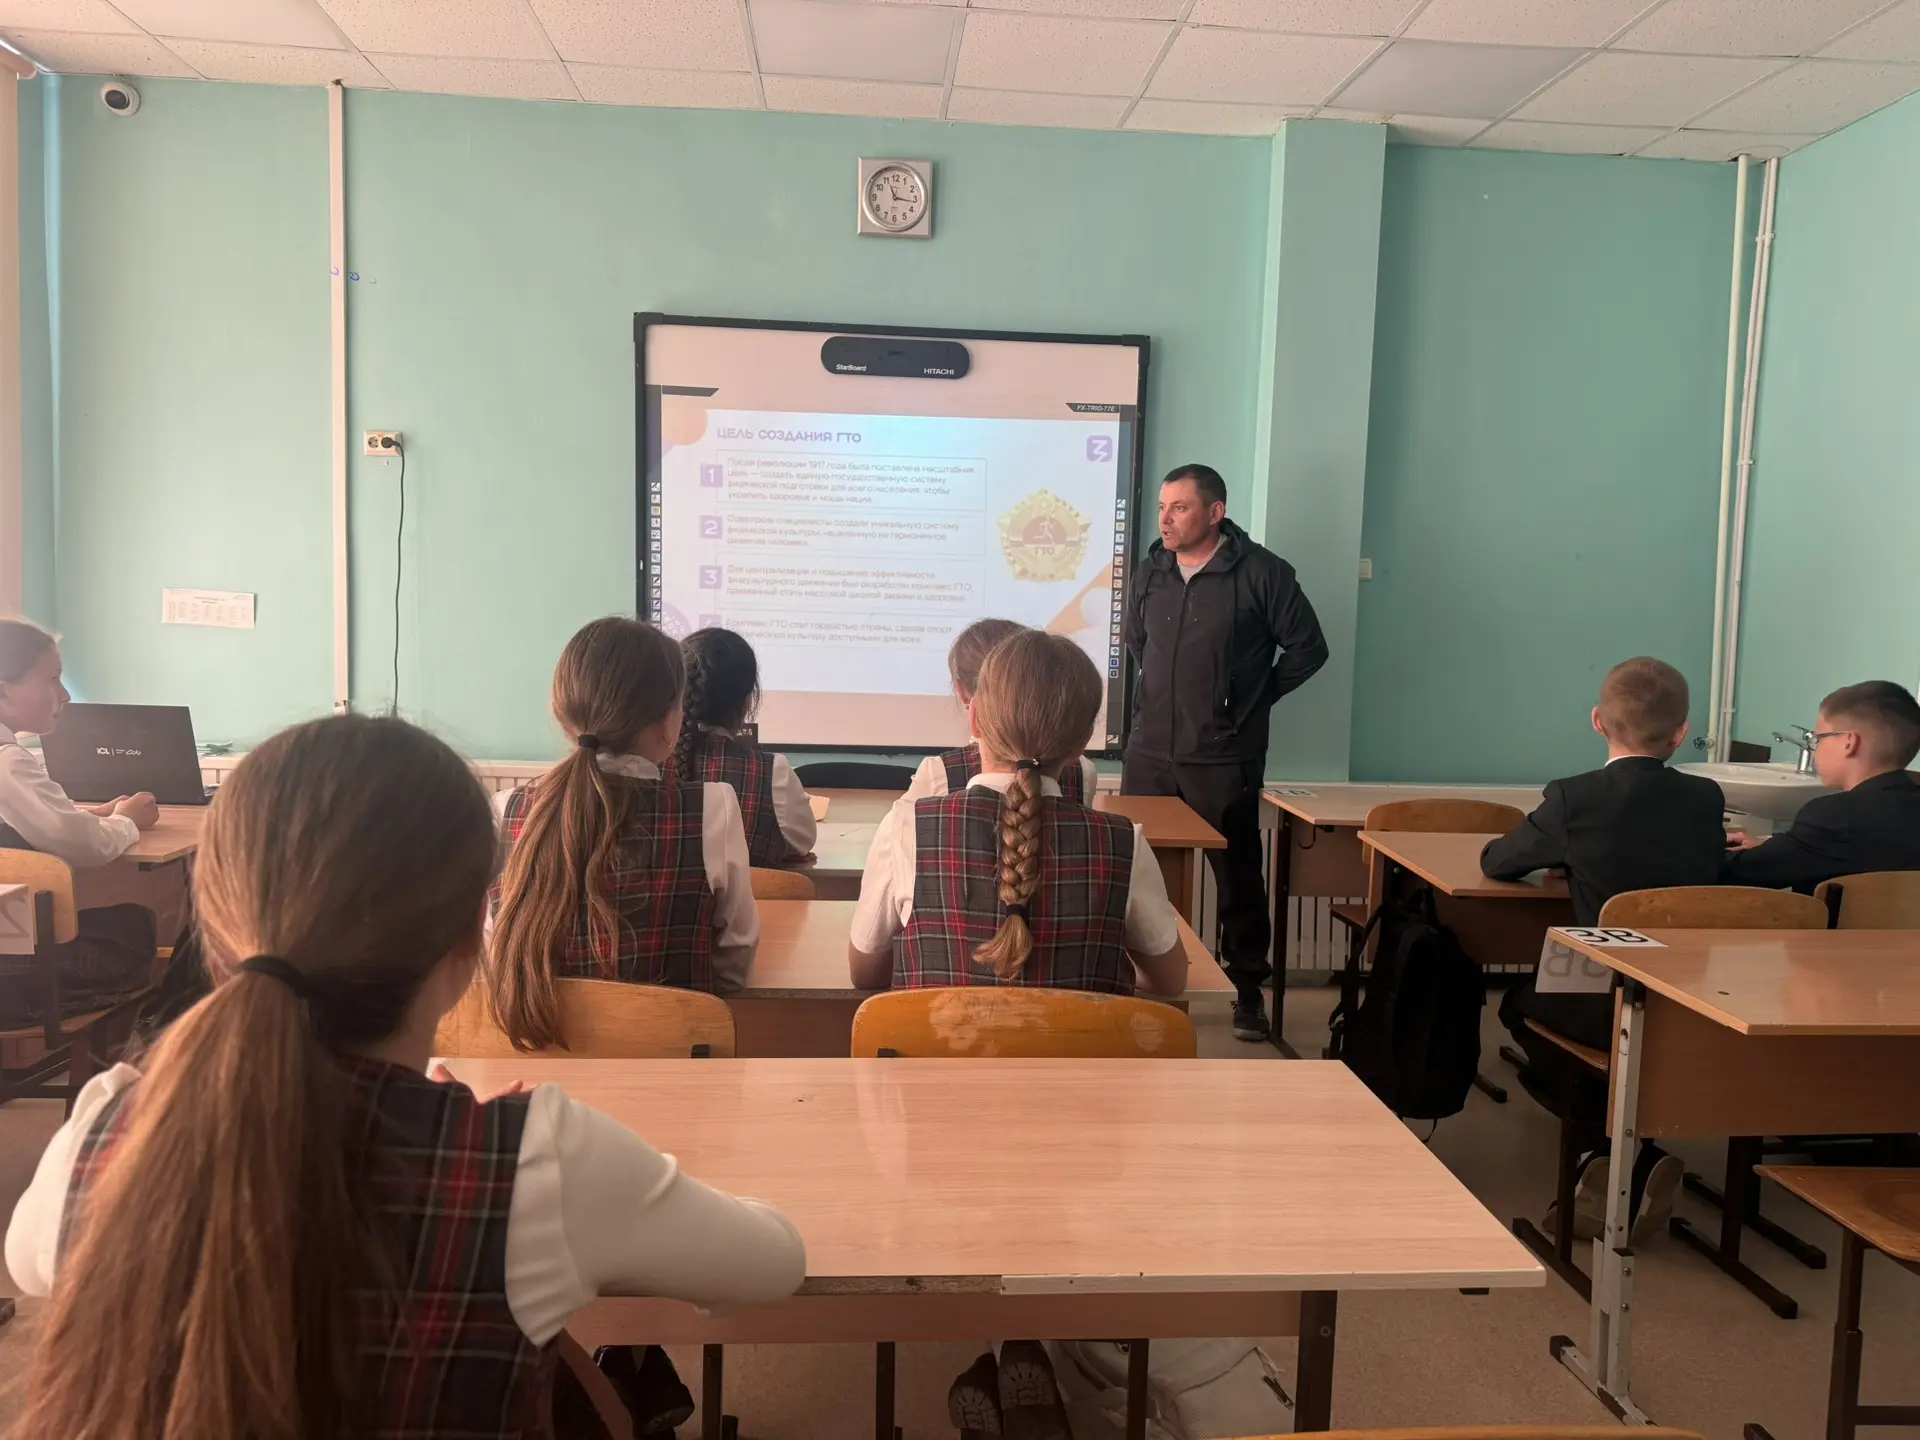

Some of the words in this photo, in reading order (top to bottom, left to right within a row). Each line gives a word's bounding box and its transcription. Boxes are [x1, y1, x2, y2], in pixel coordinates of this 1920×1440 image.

[883, 176, 890, 184] 11
[891, 174, 900, 182] 12
[903, 178, 907, 186] 1
[876, 184, 884, 192] 10
[910, 185, 915, 193] 2
[872, 194, 878, 202] 9
[912, 196, 918, 204] 3
[876, 204, 880, 212] 8
[884, 212, 888, 220] 7
[892, 214, 897, 222] 6
[836, 364, 867, 372] StarBoard
[717, 428, 754, 440] ЦЕЛЬ
[758, 430, 832, 443] СОЗДАНИЯ
[836, 432, 862, 443] ГТО
[728, 458, 755, 466] После
[808, 461, 825, 469] 1917
[848, 460, 870, 470] была
[871, 464, 921, 473] поставлена
[708, 468, 714, 483] 1
[760, 472, 794, 480] создать
[910, 476, 946, 484] систему
[704, 520, 718, 536] 2
[704, 570, 718, 584] 3
[770, 620, 788, 628] ГТО
